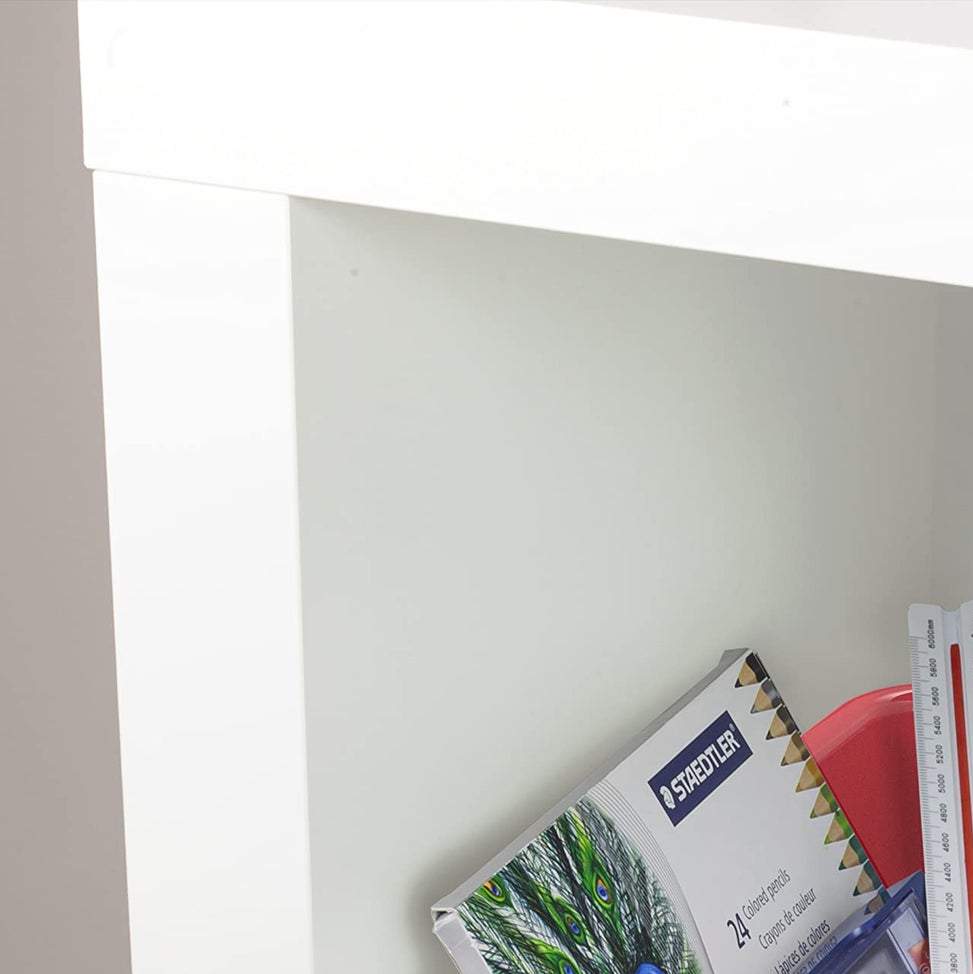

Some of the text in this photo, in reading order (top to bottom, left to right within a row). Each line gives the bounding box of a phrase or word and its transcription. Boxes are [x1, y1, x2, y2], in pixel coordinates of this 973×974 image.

[927, 619, 936, 649] 6000mm
[932, 715, 942, 736] 5400
[935, 744, 944, 764] 5200
[670, 729, 741, 802] STAEDTLER
[937, 773, 946, 794] 5000
[939, 803, 948, 823] 4800
[942, 832, 950, 852] 4600
[943, 862, 951, 882] 4400
[727, 868, 791, 950] 24 Colored pencils
[945, 892, 954, 912] 4200
[758, 888, 816, 950] Crayons de couleur
[798, 940, 810, 958] de
[806, 920, 831, 948] colores
[948, 922, 956, 942] 4000
[950, 952, 958, 973] 3800
